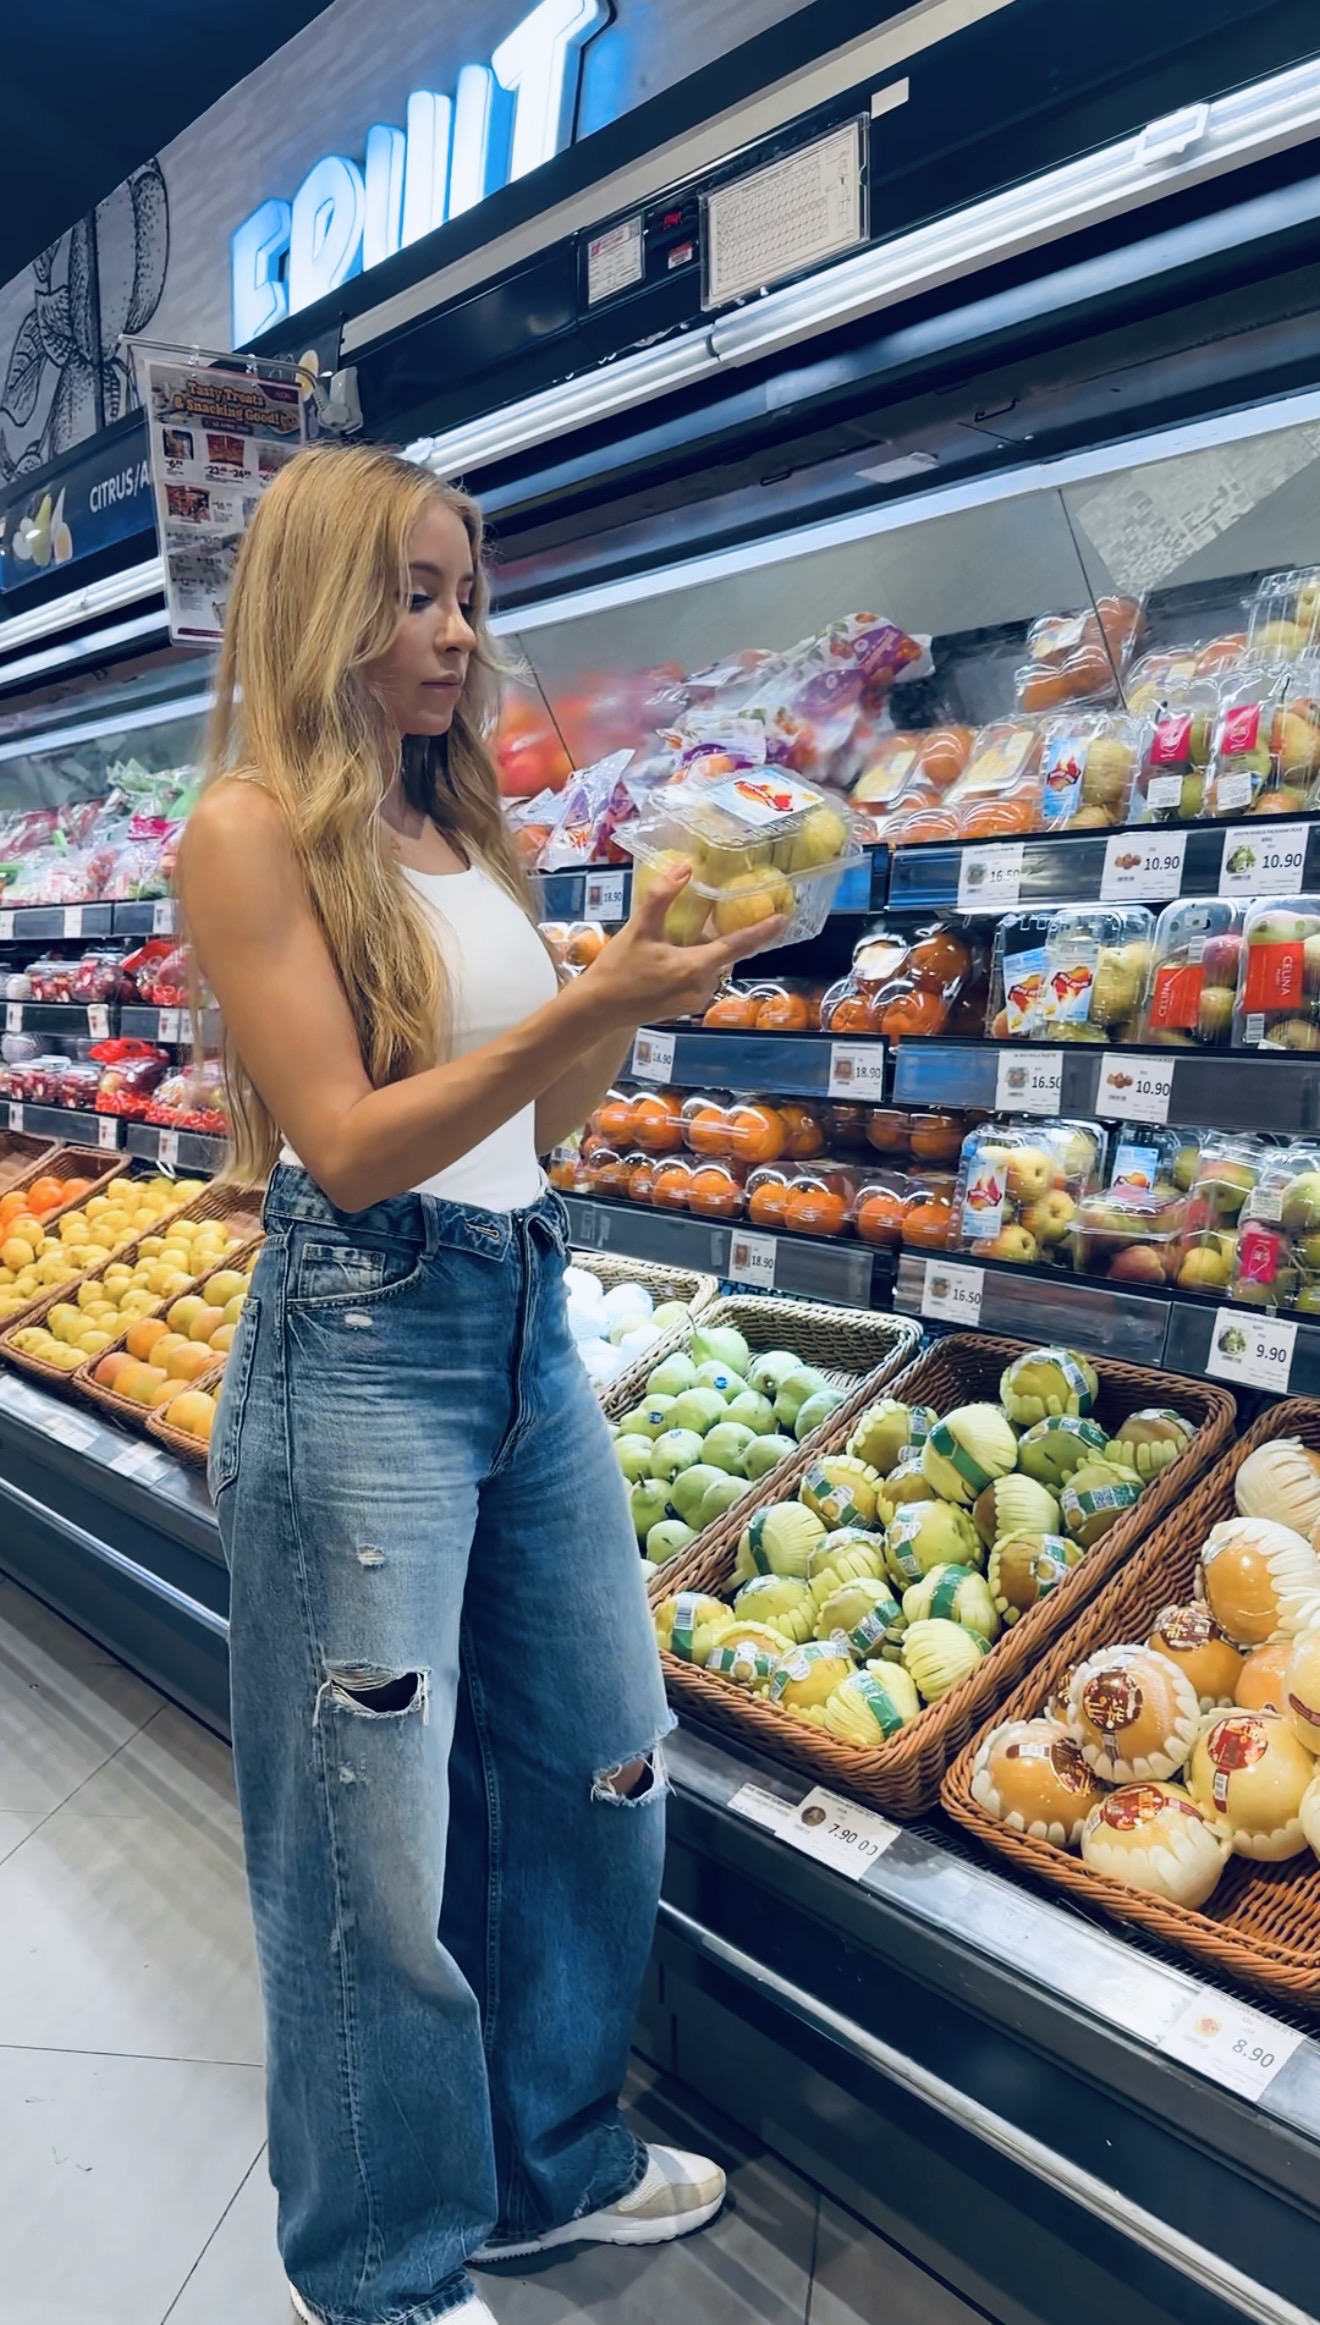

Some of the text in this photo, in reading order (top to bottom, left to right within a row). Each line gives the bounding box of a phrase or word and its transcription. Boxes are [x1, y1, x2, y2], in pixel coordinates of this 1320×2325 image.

[231, 0, 598, 350] FRUIT
[187, 381, 266, 408] Tasty Treats
[172, 394, 185, 410] &
[186, 398, 244, 423] Snacking
[245, 408, 282, 427] Good!
[1144, 855, 1180, 871] 10.90
[1262, 853, 1303, 869] 10.90
[990, 869, 1020, 883] 16.50
[1280, 955, 1293, 996] CELINA
[1158, 982, 1171, 1017] CELINA
[856, 1066, 881, 1079] 18.90
[1136, 1080, 1171, 1097] 10.90
[752, 1255, 774, 1269] 18.90
[953, 1288, 982, 1305] 16.50
[1256, 1344, 1287, 1363] 9.90
[827, 1822, 858, 1845] 7.90
[1231, 2038, 1276, 2069] 8.90
